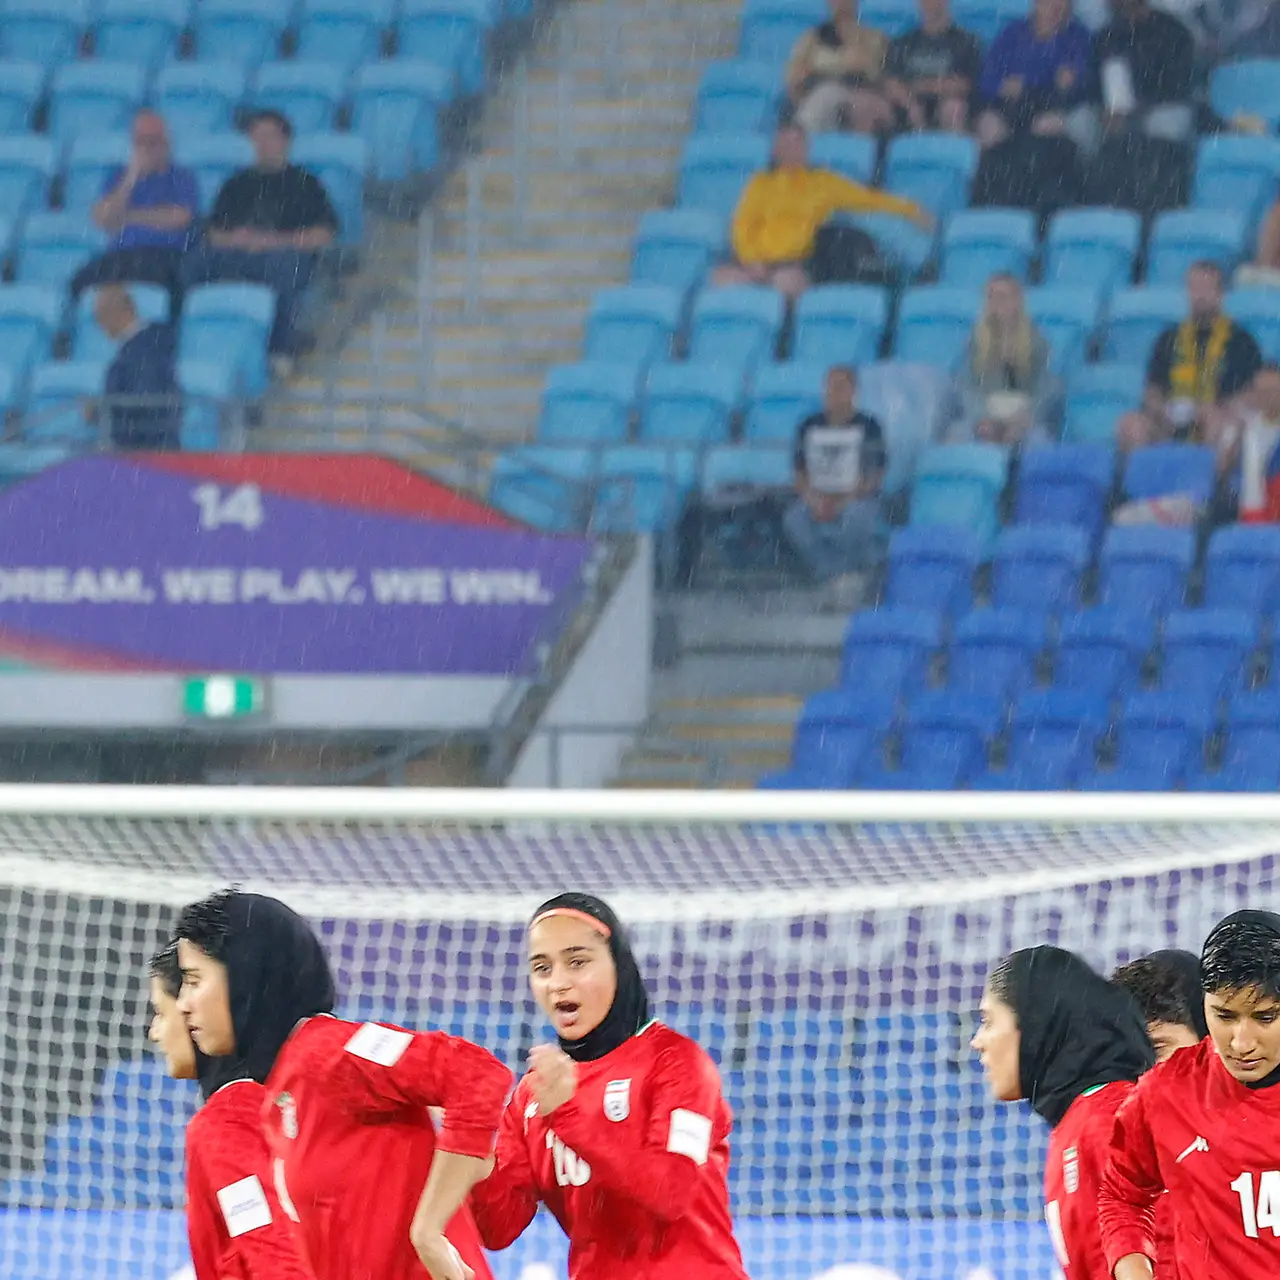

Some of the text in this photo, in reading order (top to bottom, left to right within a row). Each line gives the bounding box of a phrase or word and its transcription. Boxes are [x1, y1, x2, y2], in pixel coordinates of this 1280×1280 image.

[191, 482, 264, 530] 14
[162, 568, 237, 603] WE
[242, 568, 366, 604] PLAY.
[371, 569, 446, 603] WE
[451, 569, 553, 605] WIN.
